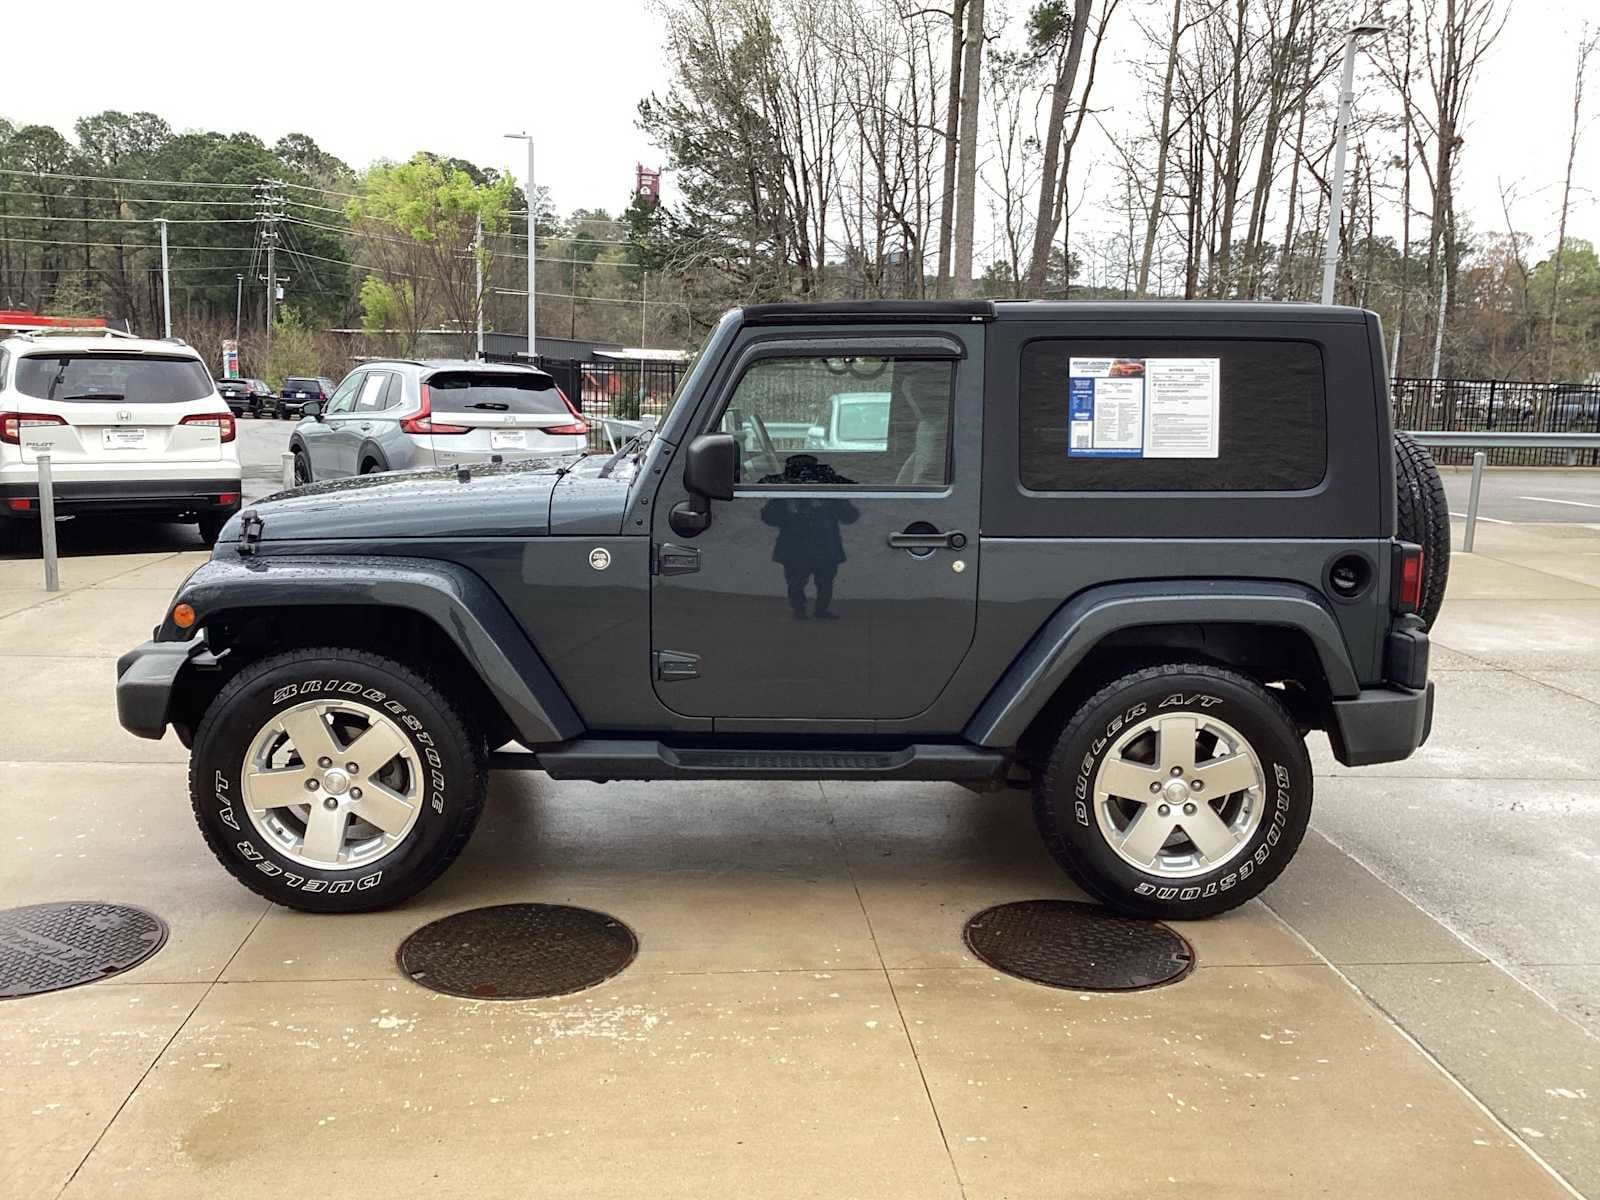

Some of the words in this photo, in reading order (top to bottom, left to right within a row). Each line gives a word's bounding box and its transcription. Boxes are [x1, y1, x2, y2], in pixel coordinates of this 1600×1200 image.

[215, 770, 241, 831] A/T
[272, 679, 445, 815] BRIDGESTONE
[1075, 702, 1148, 827] DUELER
[1158, 693, 1224, 708] A/T
[236, 840, 383, 894] DUELER
[1133, 762, 1290, 901] BRIDGESTONE
